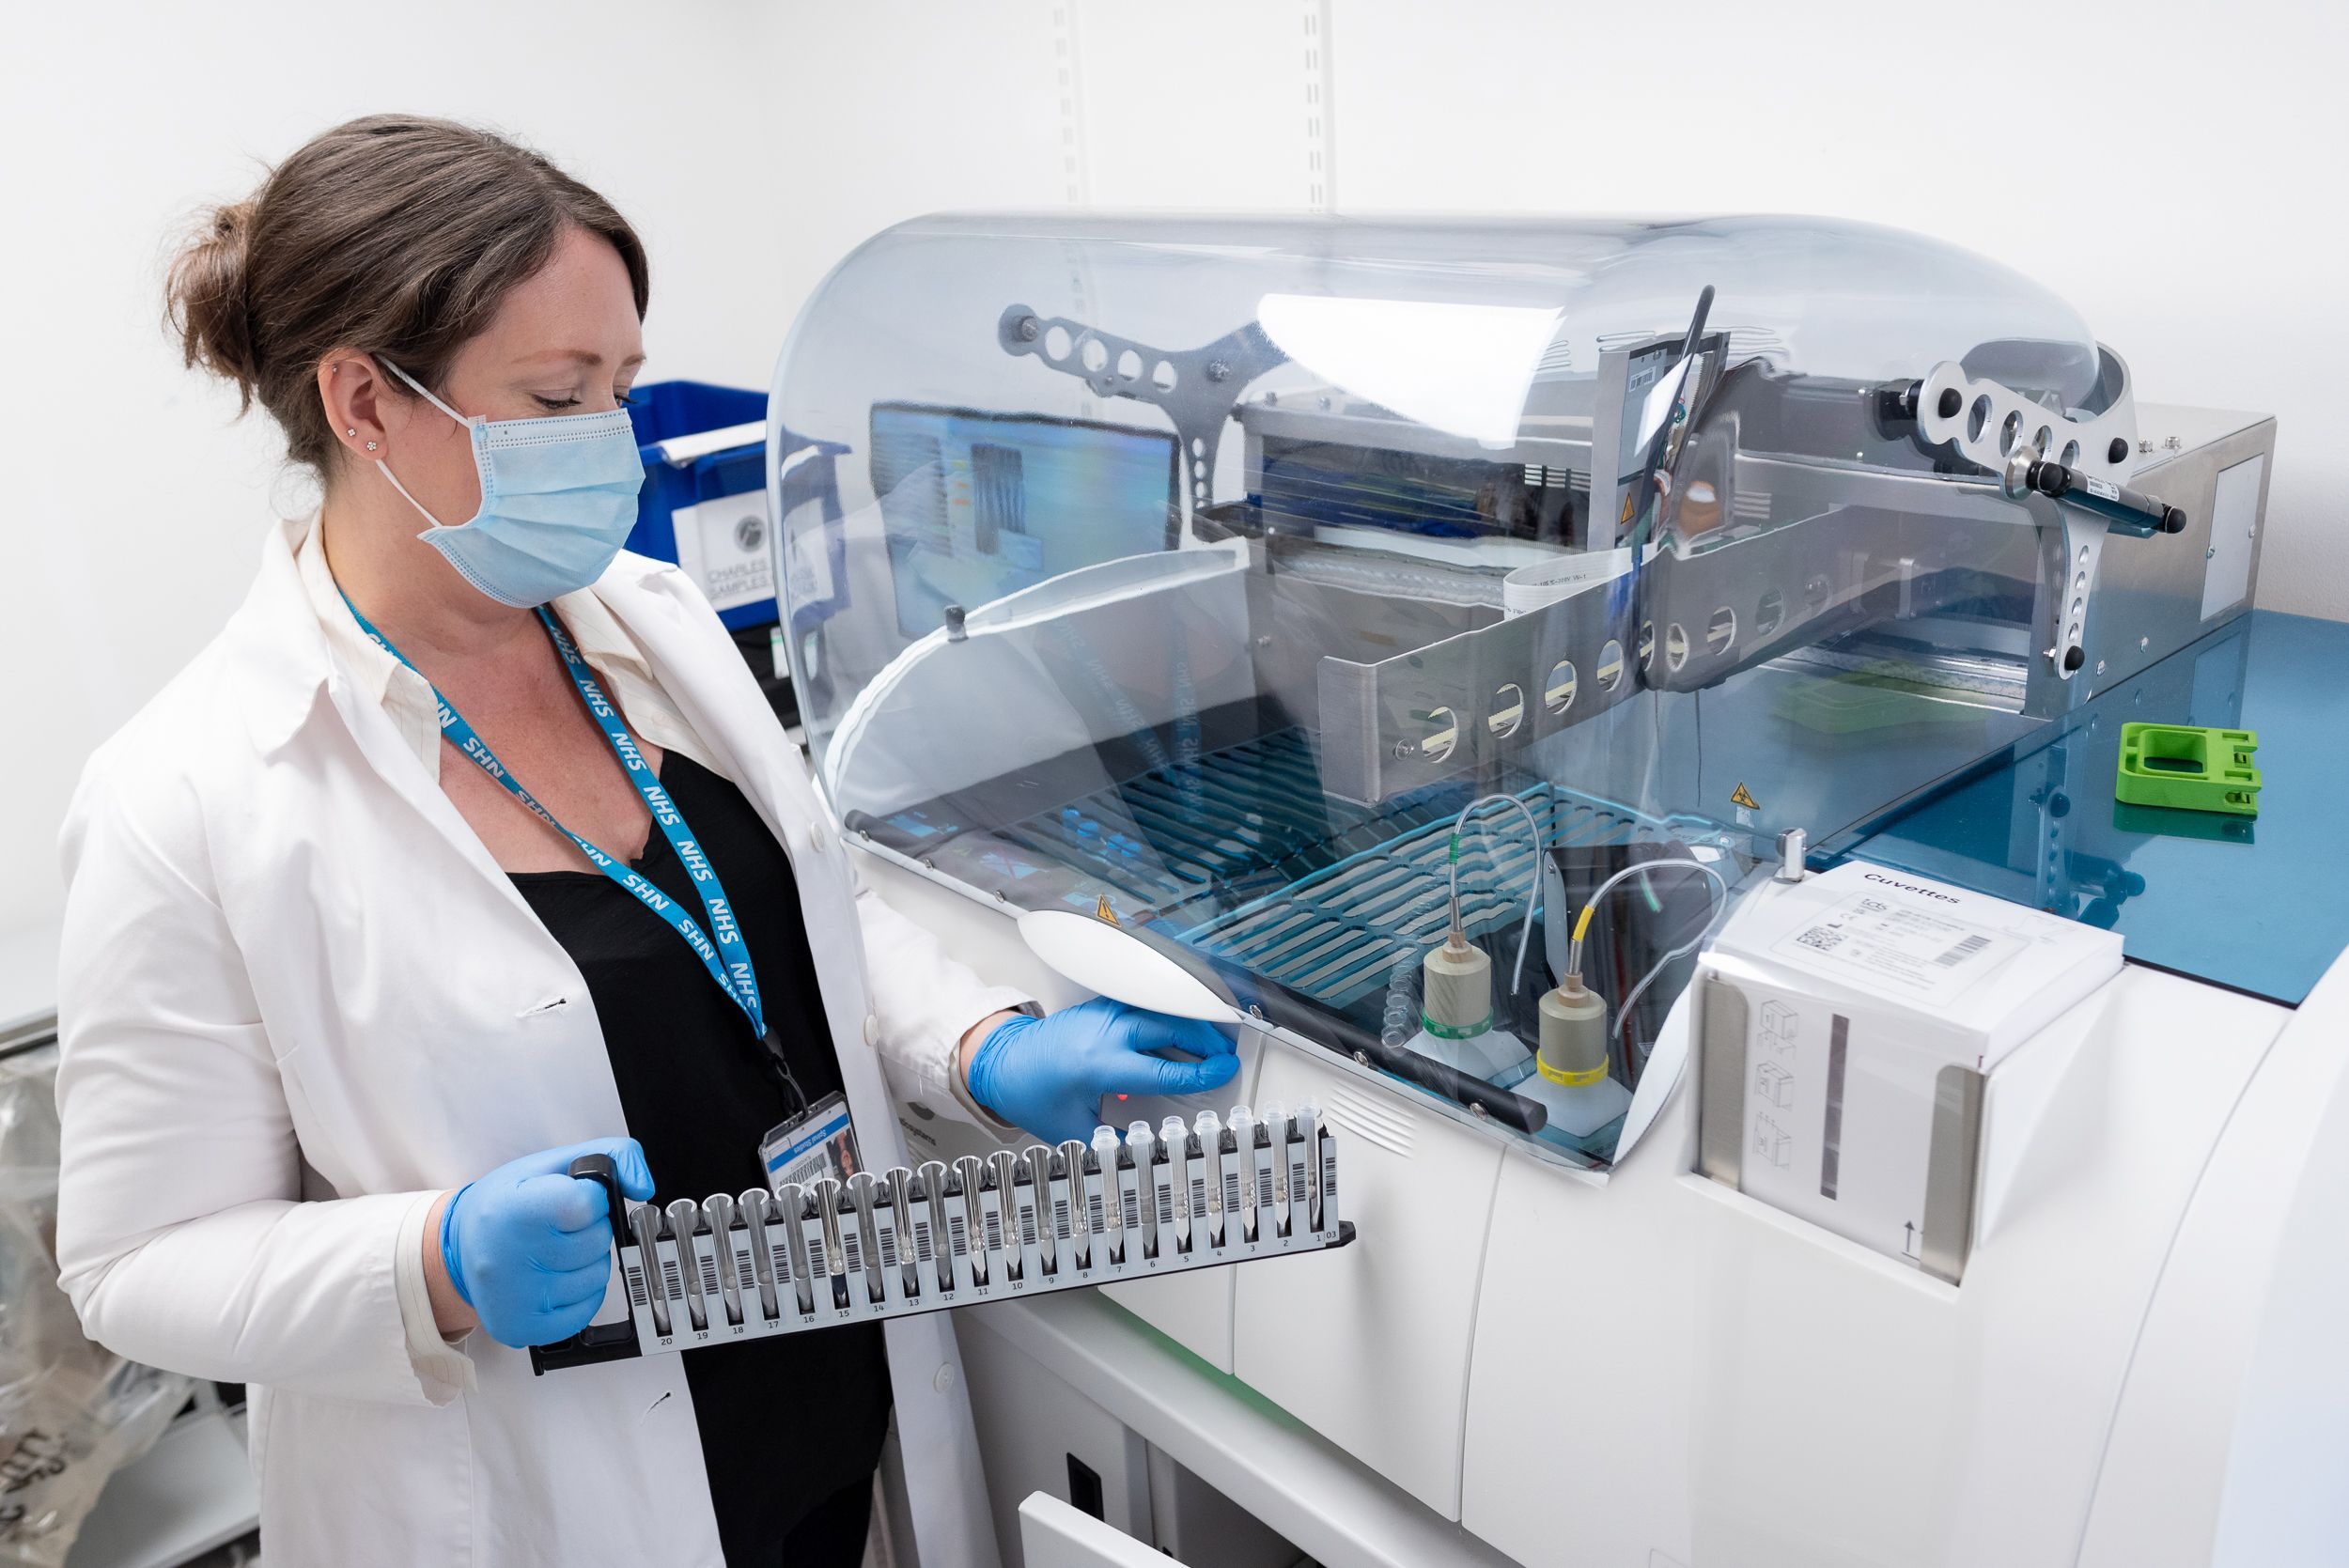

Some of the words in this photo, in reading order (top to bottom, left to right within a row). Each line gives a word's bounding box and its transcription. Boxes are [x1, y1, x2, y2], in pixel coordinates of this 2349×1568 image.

[462, 737, 505, 779] NHS
[550, 626, 581, 665] NHS
[580, 679, 614, 719] NHS
[612, 732, 647, 772] NHS
[642, 786, 679, 827] NHS
[677, 841, 712, 881] NHS
[708, 898, 739, 945] NHS
[730, 963, 756, 1008] NHS
[575, 836, 612, 868] NH
[623, 875, 669, 909] NHS
[1864, 872, 1961, 905] Cuvettes
[679, 919, 713, 960] NHS
[812, 1129, 826, 1143] Spinal
[802, 1314, 815, 1323] 16
[909, 1297, 920, 1306] 13
